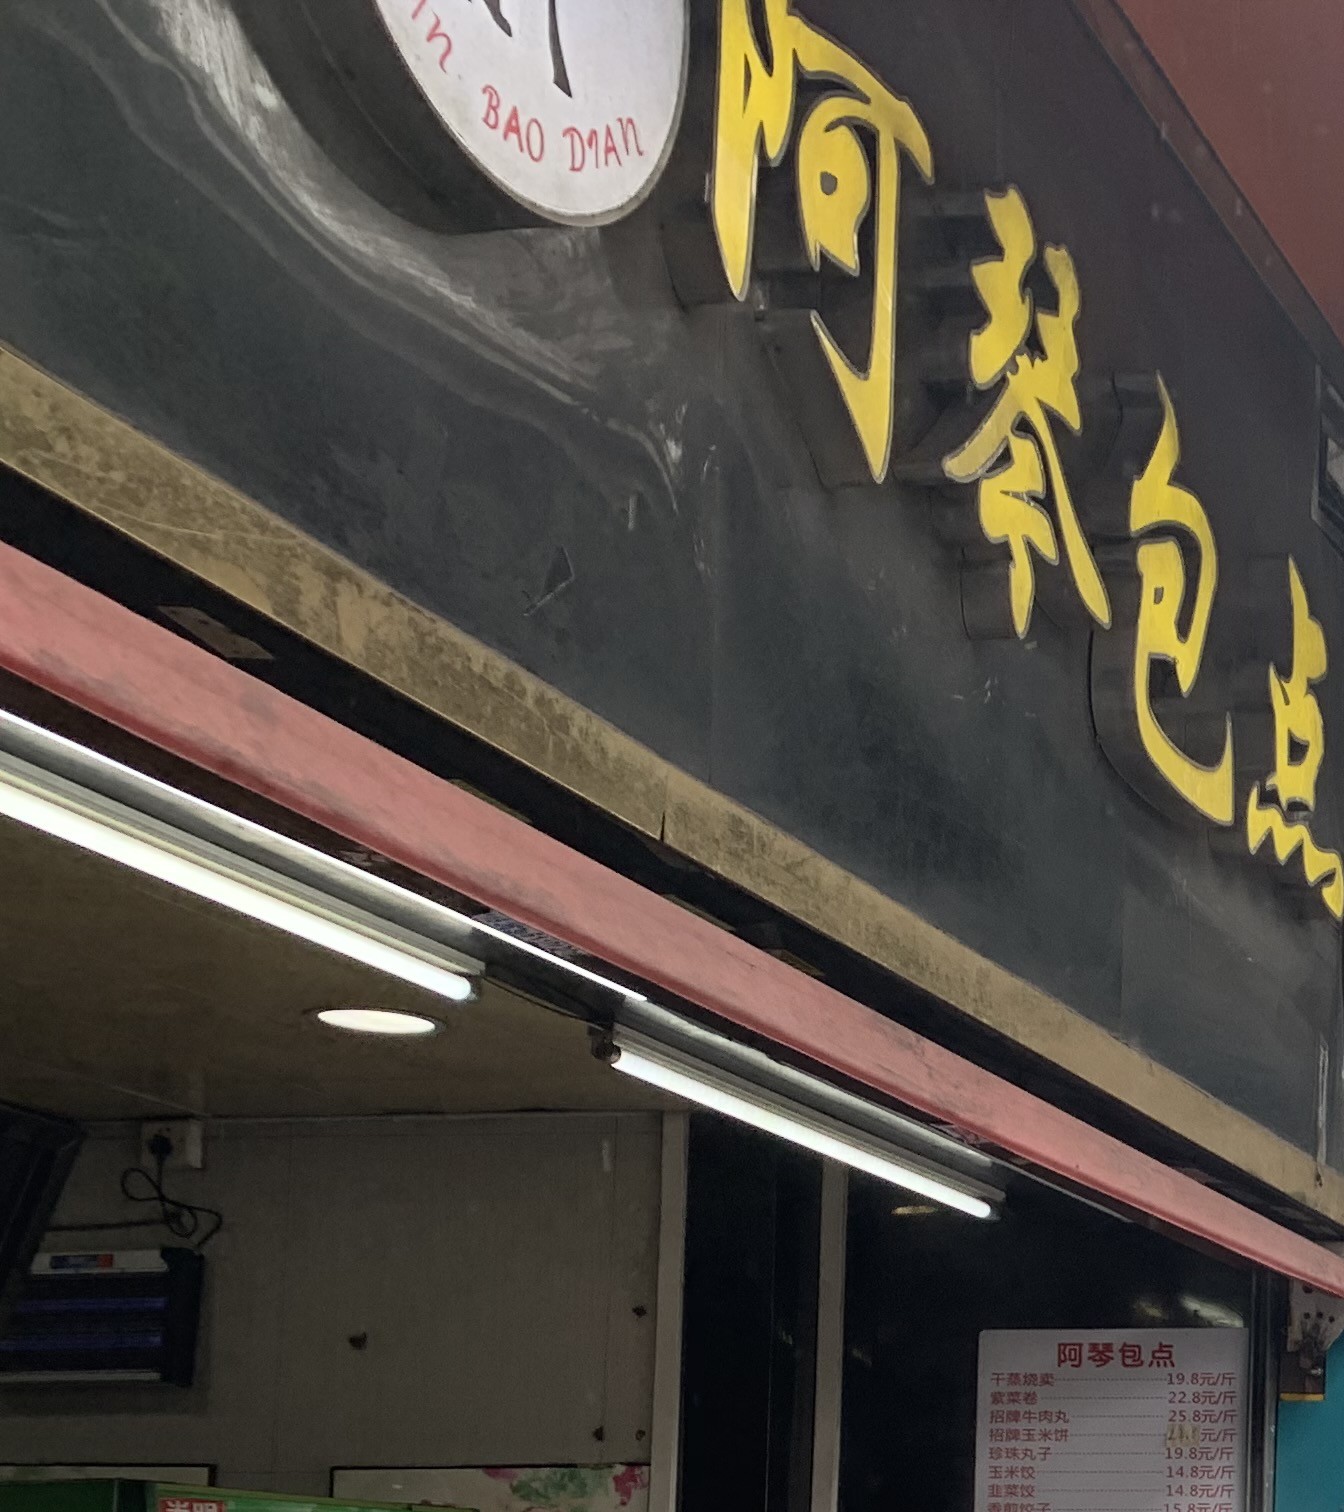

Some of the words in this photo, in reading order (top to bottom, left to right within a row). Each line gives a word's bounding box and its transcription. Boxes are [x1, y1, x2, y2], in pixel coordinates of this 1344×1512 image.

[481, 84, 545, 162] BAO
[562, 117, 644, 172] DIAN
[1057, 1342, 1176, 1368] 阿琴包点
[1166, 1373, 1237, 1387] 19.8元/斤
[1167, 1391, 1238, 1406] 22.8元/斤
[989, 1410, 1070, 1424] 招牌牛肉丸
[1167, 1410, 1239, 1424] 25.8元/斤
[988, 1429, 1070, 1443] 招牌玉米饼
[988, 1447, 1052, 1461] 珍珠丸子
[1164, 1447, 1236, 1461] 19.8元/斤
[988, 1466, 1036, 1480] 玉米饺
[1166, 1466, 1236, 1480] 14.8元/斤
[988, 1484, 1036, 1498] 韭菜饺
[1166, 1484, 1236, 1498] 14.8元/斤
